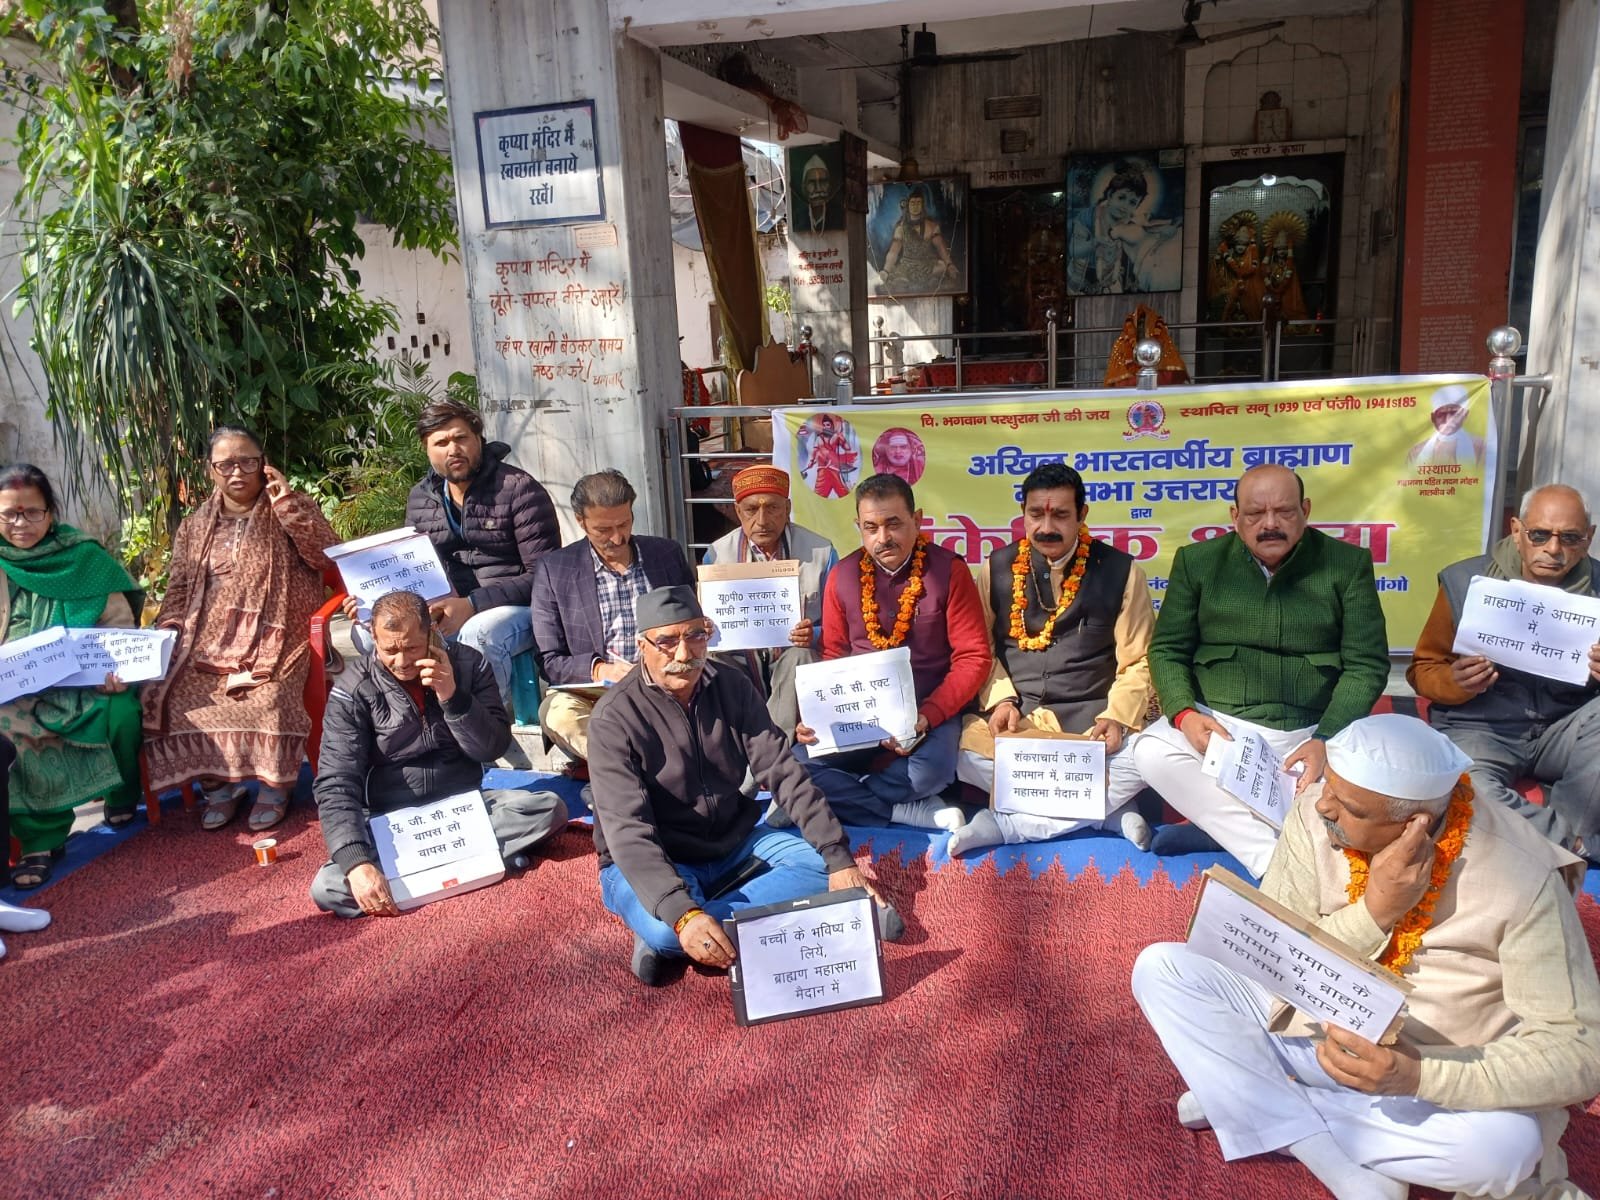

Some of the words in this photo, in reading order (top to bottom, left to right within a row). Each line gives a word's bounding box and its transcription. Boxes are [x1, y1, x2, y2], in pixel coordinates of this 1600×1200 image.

[532, 126, 561, 148] मंदिर
[564, 119, 575, 146] में
[500, 160, 542, 180] स्वच्छता
[545, 153, 578, 175] बनाये
[496, 261, 532, 285] कृपया
[580, 250, 592, 272] में
[599, 338, 624, 353] समय
[1180, 402, 1238, 418] स्थापित
[1245, 404, 1270, 418] सन्
[1273, 402, 1298, 414] 1939
[1303, 398, 1322, 413] एवं
[943, 415, 987, 427] भगवान
[990, 413, 1039, 430] परशुराम
[1043, 409, 1060, 423] जी
[1063, 408, 1082, 422] की
[1085, 410, 1110, 421] जय
[1074, 440, 1234, 472] भारतवर्षीय
[1417, 462, 1461, 475] संस्थापक
[1446, 486, 1456, 496] जी
[1131, 507, 1152, 520] द्वारा
[402, 551, 415, 561] का
[359, 575, 391, 590] अपमान
[748, 591, 776, 601] सरकार
[781, 588, 789, 598] के
[715, 605, 735, 616] माफी
[740, 606, 749, 614] ना
[1532, 602, 1546, 616] के
[1551, 608, 1597, 628] अपमान
[753, 618, 764, 628] का
[768, 617, 790, 628] धरना
[1477, 631, 1525, 652] महासभा
[1531, 640, 1564, 660] मैदान
[1571, 649, 1582, 664] में
[24, 660, 38, 672] की
[830, 683, 846, 697] जी.
[849, 680, 865, 693] सी.
[869, 677, 890, 690] एक्ट
[834, 701, 860, 714] वापस
[863, 696, 877, 709] लो
[838, 721, 863, 734] वापस
[866, 715, 880, 728] लो
[1013, 750, 1058, 763] शंकराचार्य
[1063, 752, 1077, 764] जी
[1081, 753, 1091, 764] के
[1012, 770, 1045, 780] अपमान
[1012, 787, 1049, 798] महासभा
[1054, 786, 1079, 799] मैदान
[408, 815, 426, 827] जी.
[430, 809, 447, 821] सी.
[452, 803, 474, 816] एक्ट
[413, 827, 442, 841] वापस
[448, 820, 461, 833] लो
[418, 843, 447, 858] वापस
[453, 836, 466, 849] लो
[759, 929, 787, 947] बच्चों
[793, 926, 806, 942] के
[811, 922, 844, 940] भविष्य
[850, 916, 862, 931] के
[1223, 922, 1283, 965] अपमान
[814, 959, 857, 978] महासभा
[1287, 944, 1342, 983] समाज
[1352, 982, 1372, 999] के
[795, 985, 825, 1001] मैदान
[831, 979, 840, 994] में
[1221, 936, 1285, 982] महासभा
[1294, 982, 1340, 1018] मैदान
[1349, 1015, 1365, 1031] में
